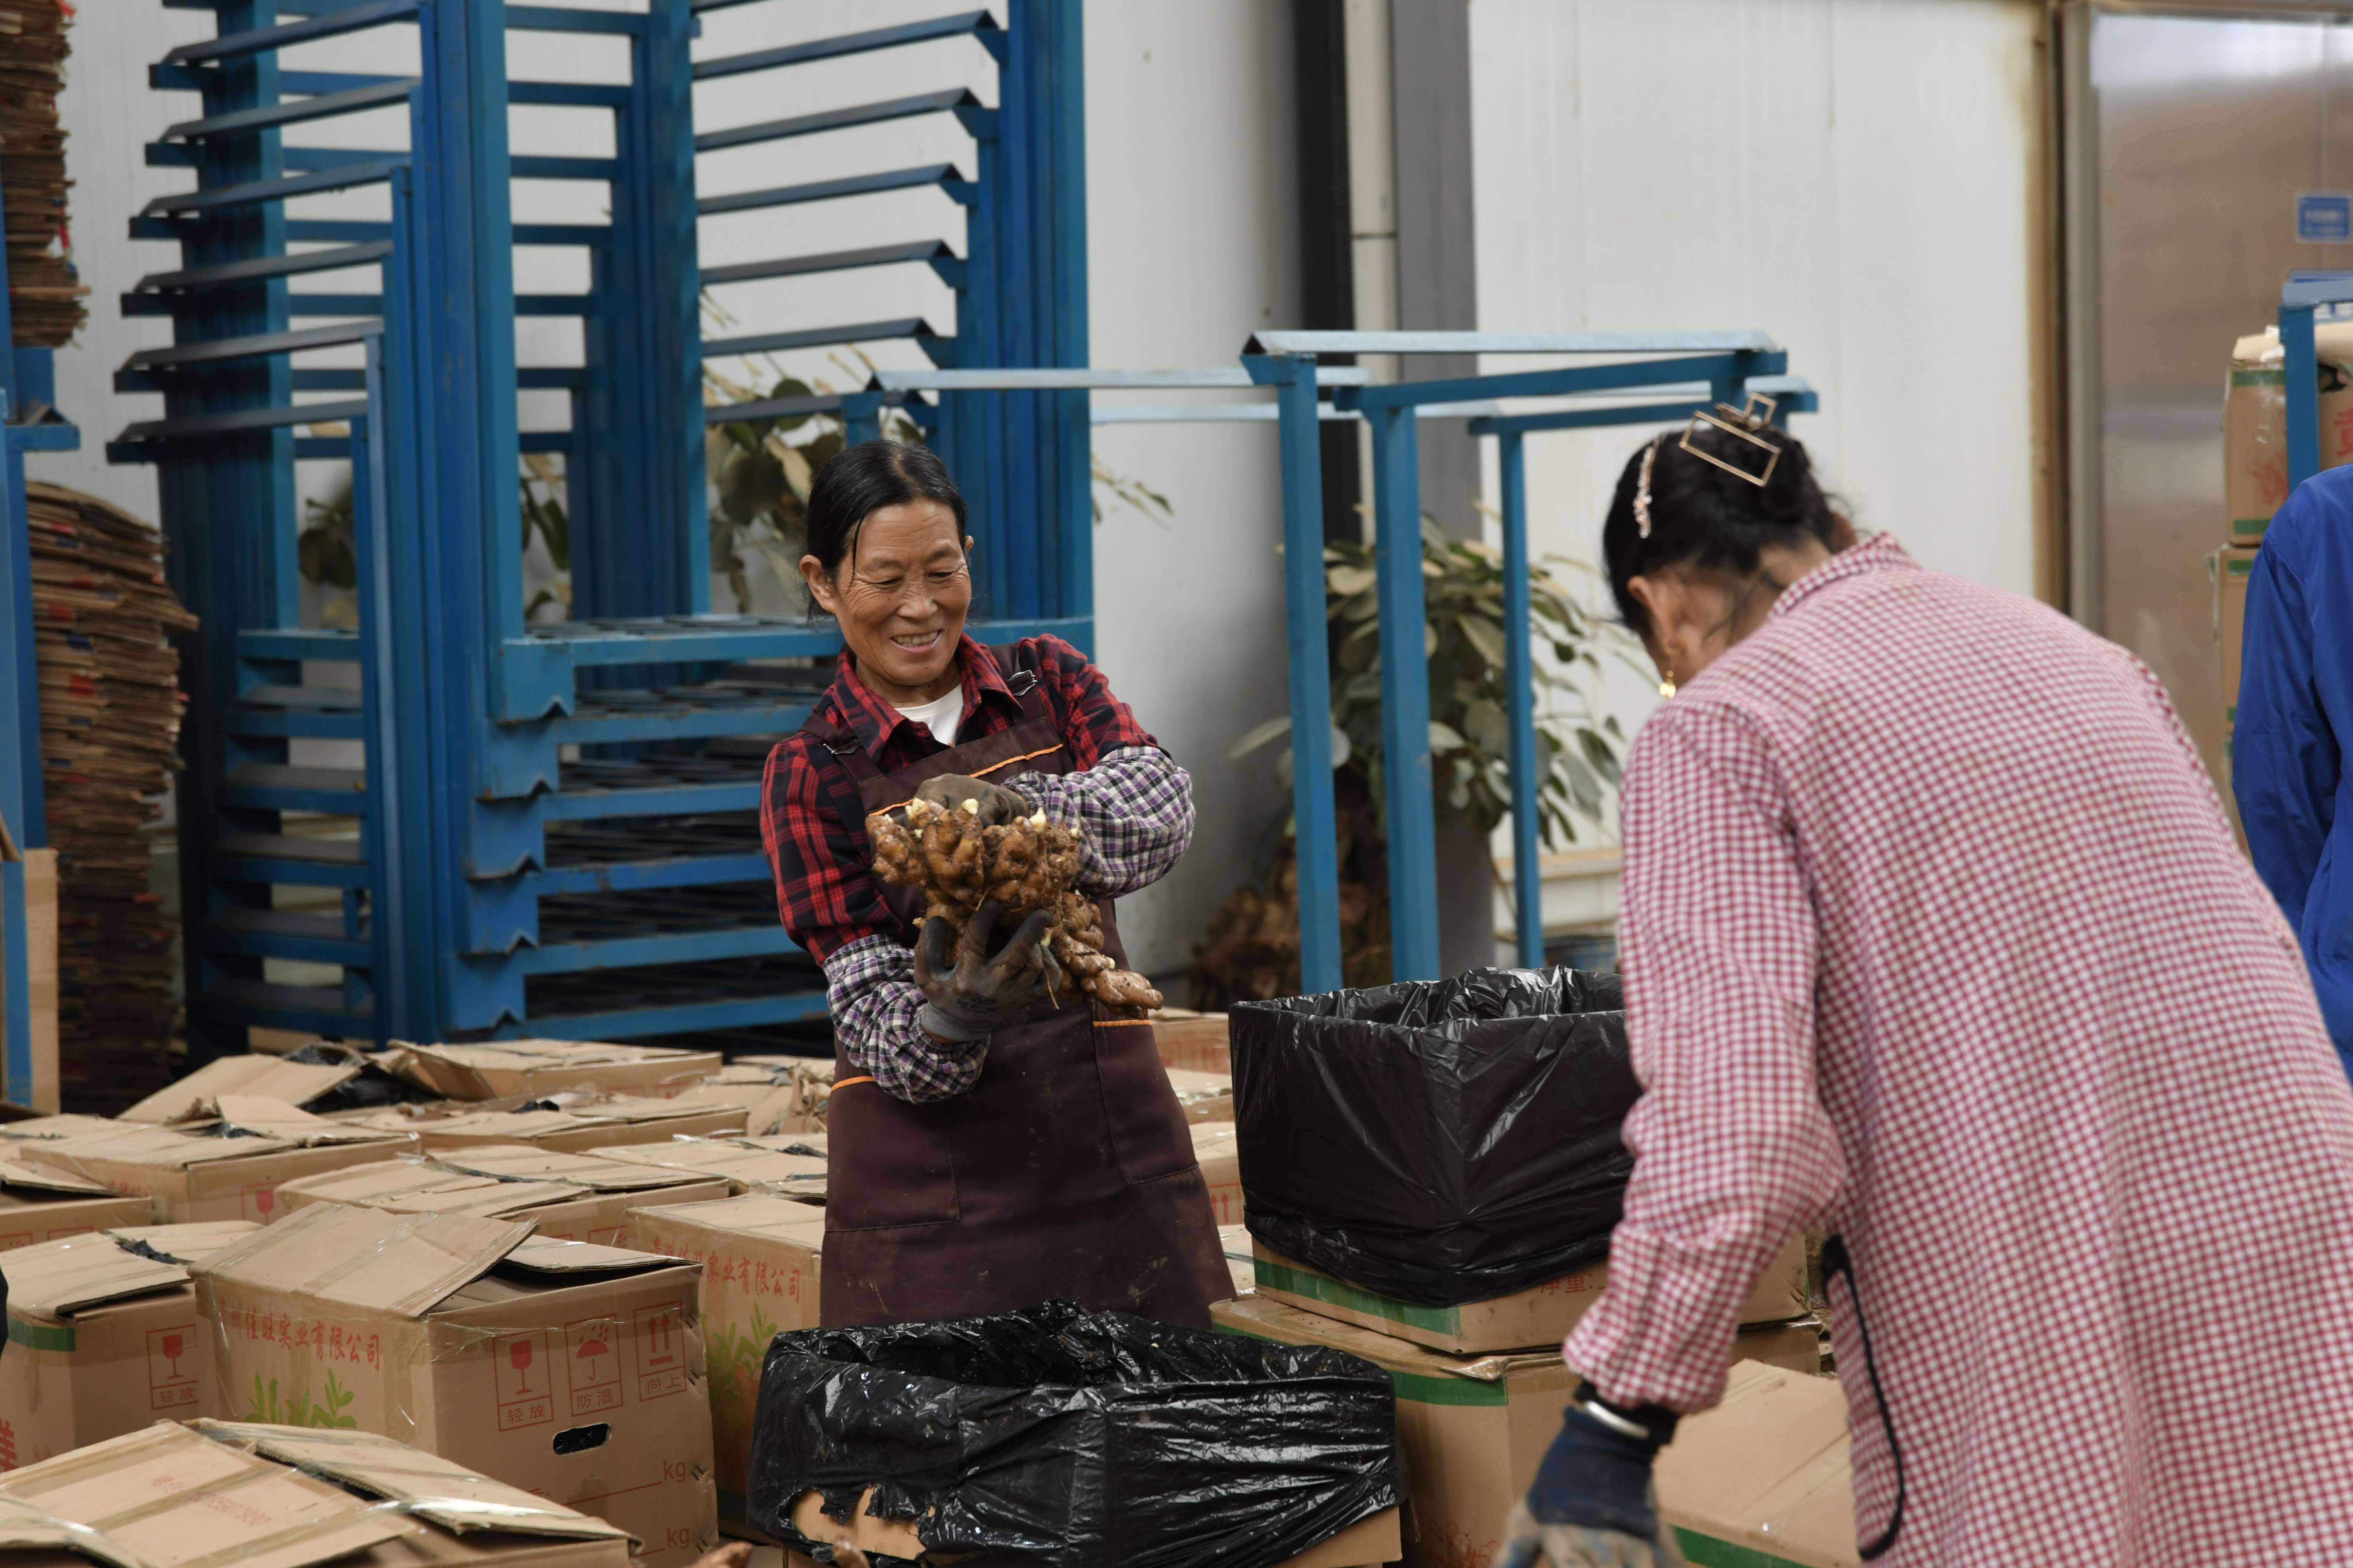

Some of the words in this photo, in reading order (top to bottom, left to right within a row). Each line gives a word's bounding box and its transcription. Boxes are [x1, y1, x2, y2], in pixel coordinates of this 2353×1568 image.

[647, 1374, 681, 1394] 向上
[576, 1388, 613, 1410] 防湿
[507, 1403, 545, 1424] 轻放
[664, 1461, 686, 1483] kg
[667, 1527, 690, 1549] kg
